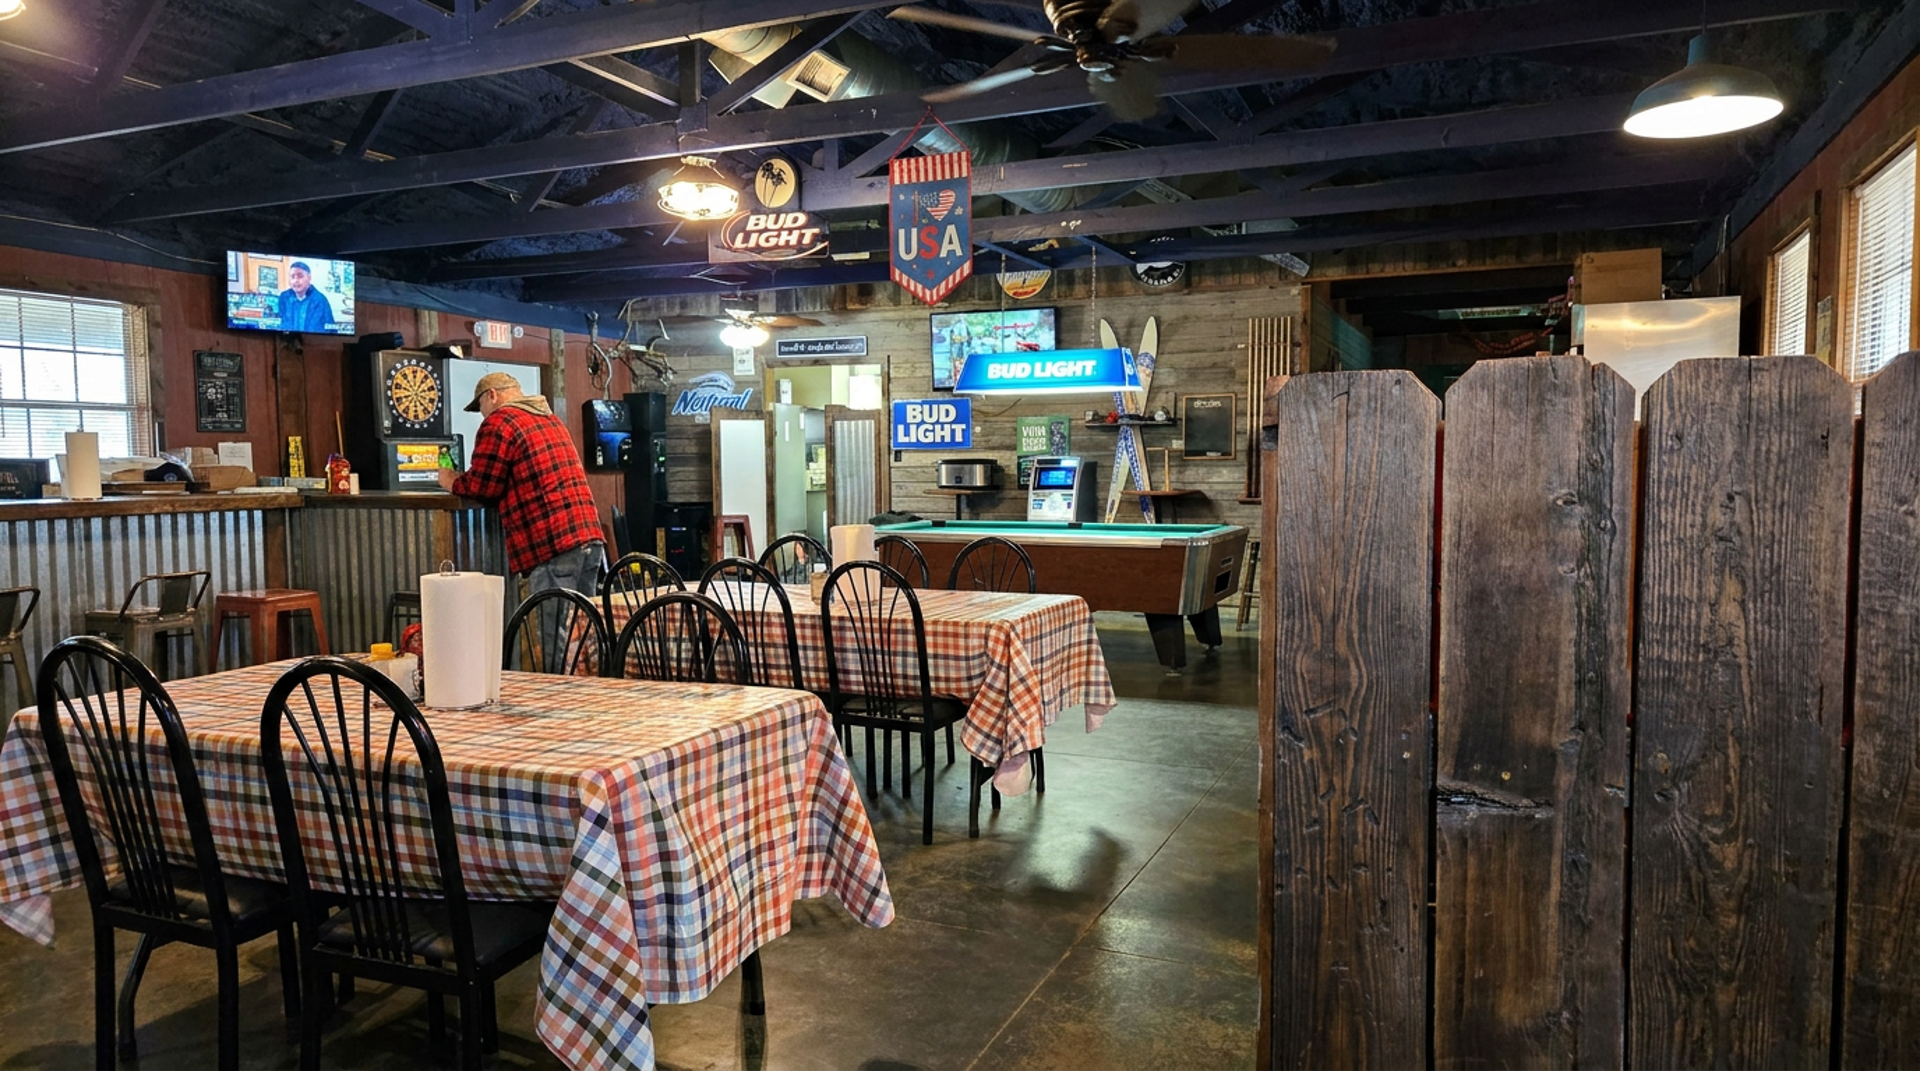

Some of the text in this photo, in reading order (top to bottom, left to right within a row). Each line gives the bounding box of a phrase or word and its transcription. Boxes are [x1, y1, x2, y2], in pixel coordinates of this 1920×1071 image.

[745, 211, 808, 231] BUD
[733, 227, 821, 249] LIGHT
[898, 224, 964, 261] USA
[987, 360, 1097, 379] BUD LIGHT
[906, 404, 957, 424] BUD
[897, 423, 967, 443] LIGHT
